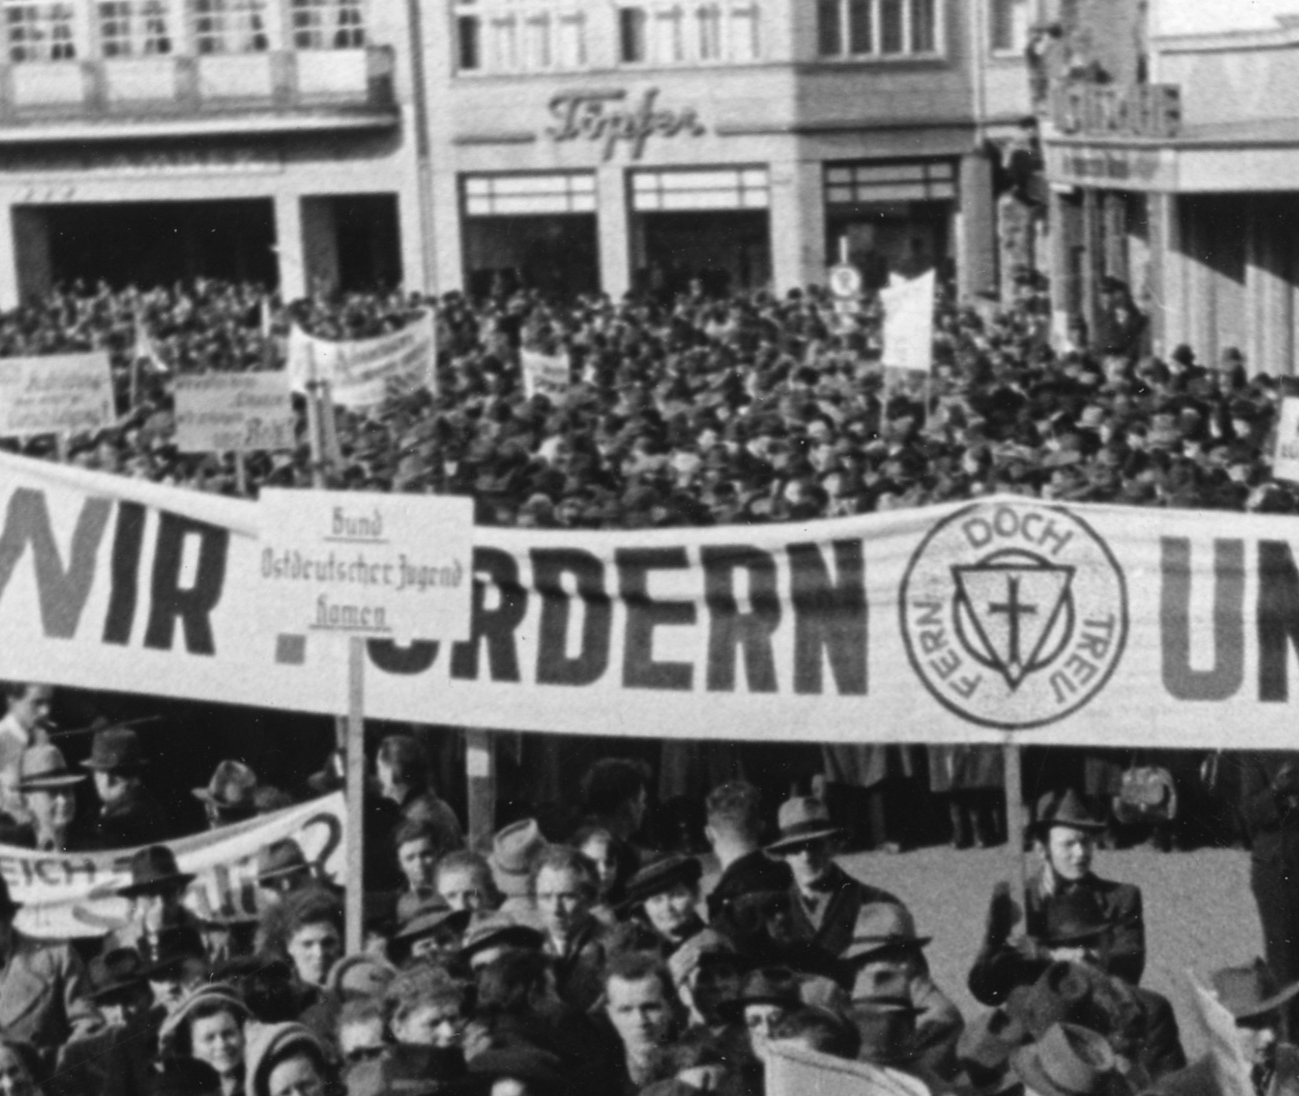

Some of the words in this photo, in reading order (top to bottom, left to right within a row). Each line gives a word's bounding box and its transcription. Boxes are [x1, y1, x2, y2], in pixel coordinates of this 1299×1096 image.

[545, 87, 706, 160] Töpfer
[961, 506, 1075, 556] DOCH
[275, 538, 869, 697] RDERN
[1047, 612, 1116, 705] TREU
